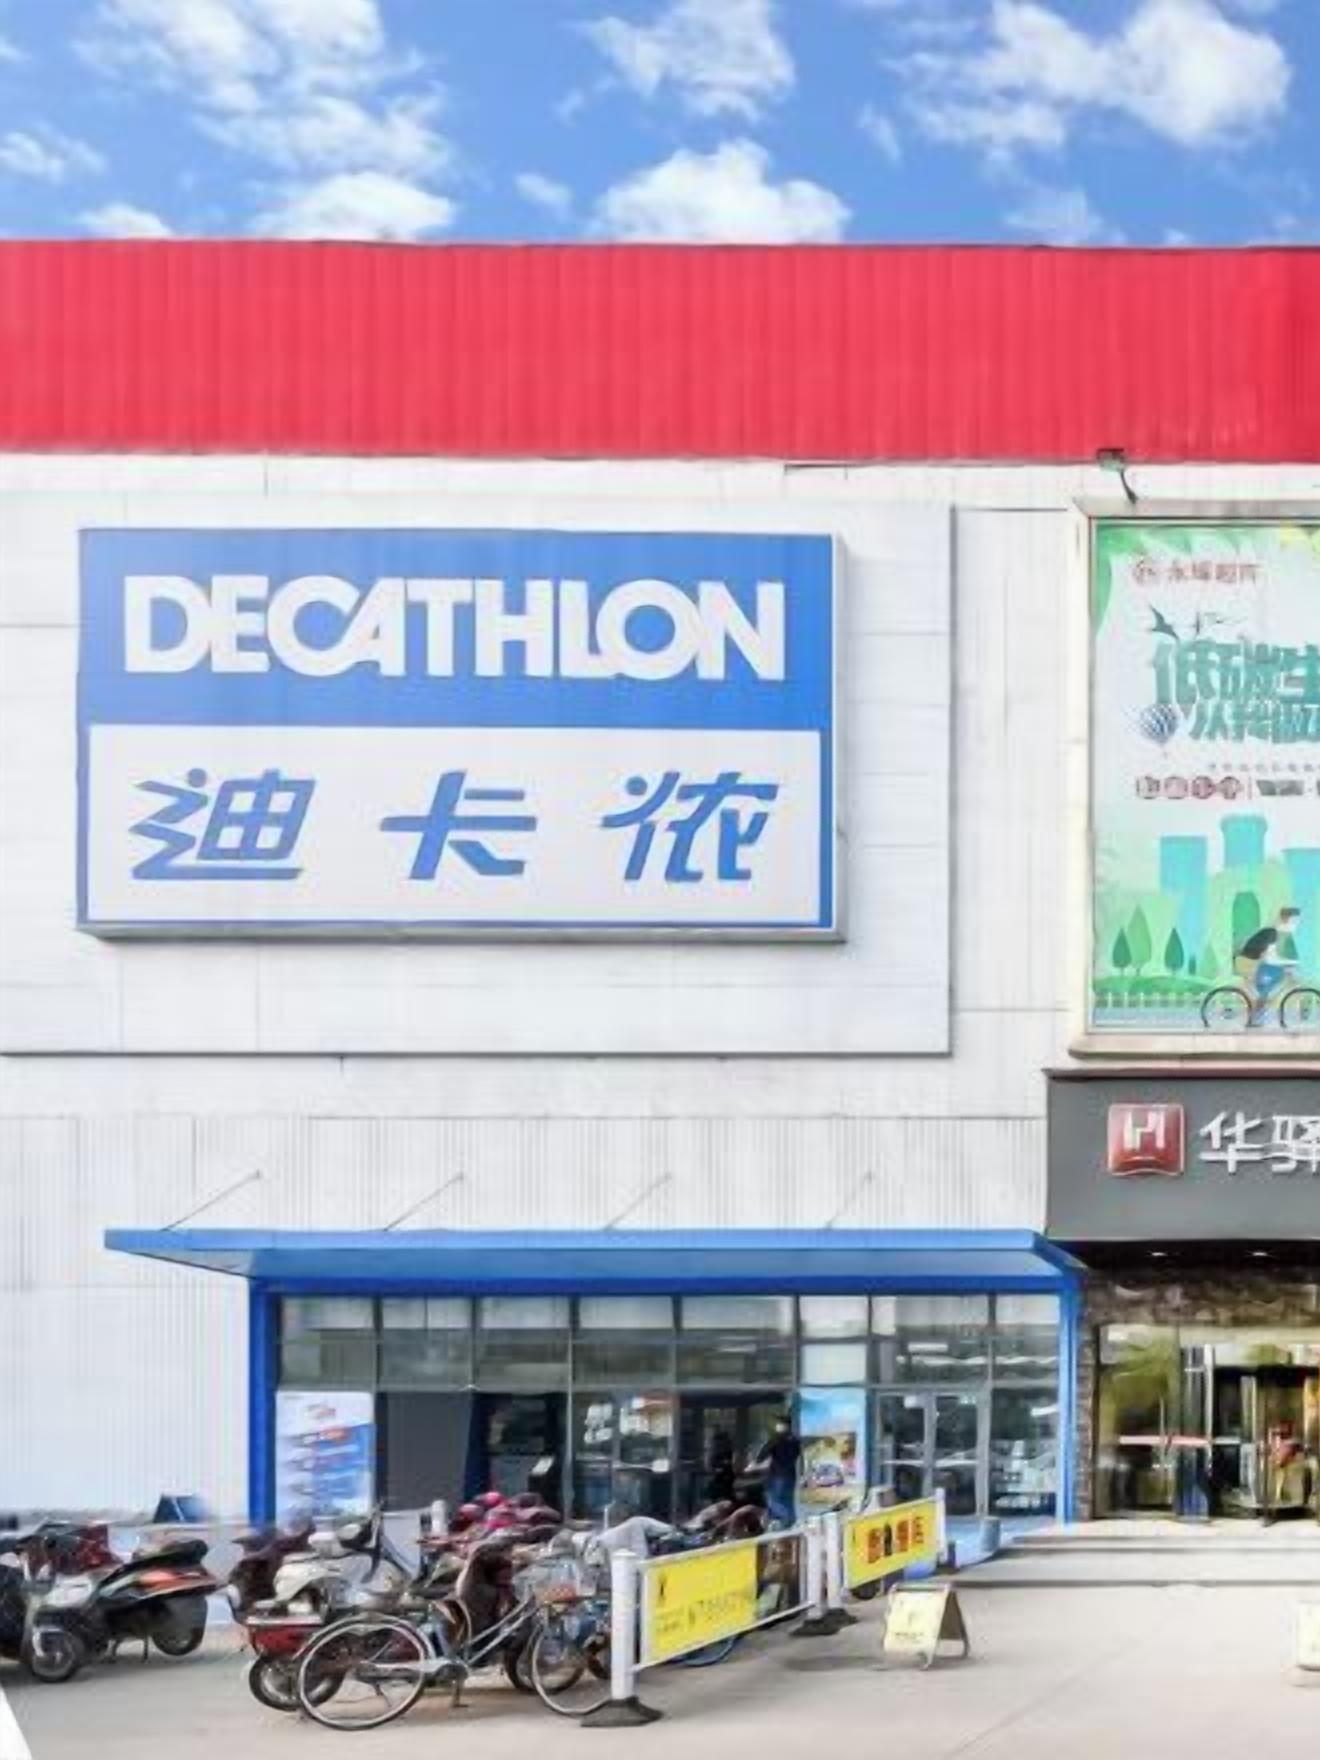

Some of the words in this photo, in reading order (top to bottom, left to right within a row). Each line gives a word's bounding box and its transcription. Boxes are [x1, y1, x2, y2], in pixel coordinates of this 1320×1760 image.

[124, 574, 786, 682] DECATHLON
[128, 768, 779, 882] 迪卡侬
